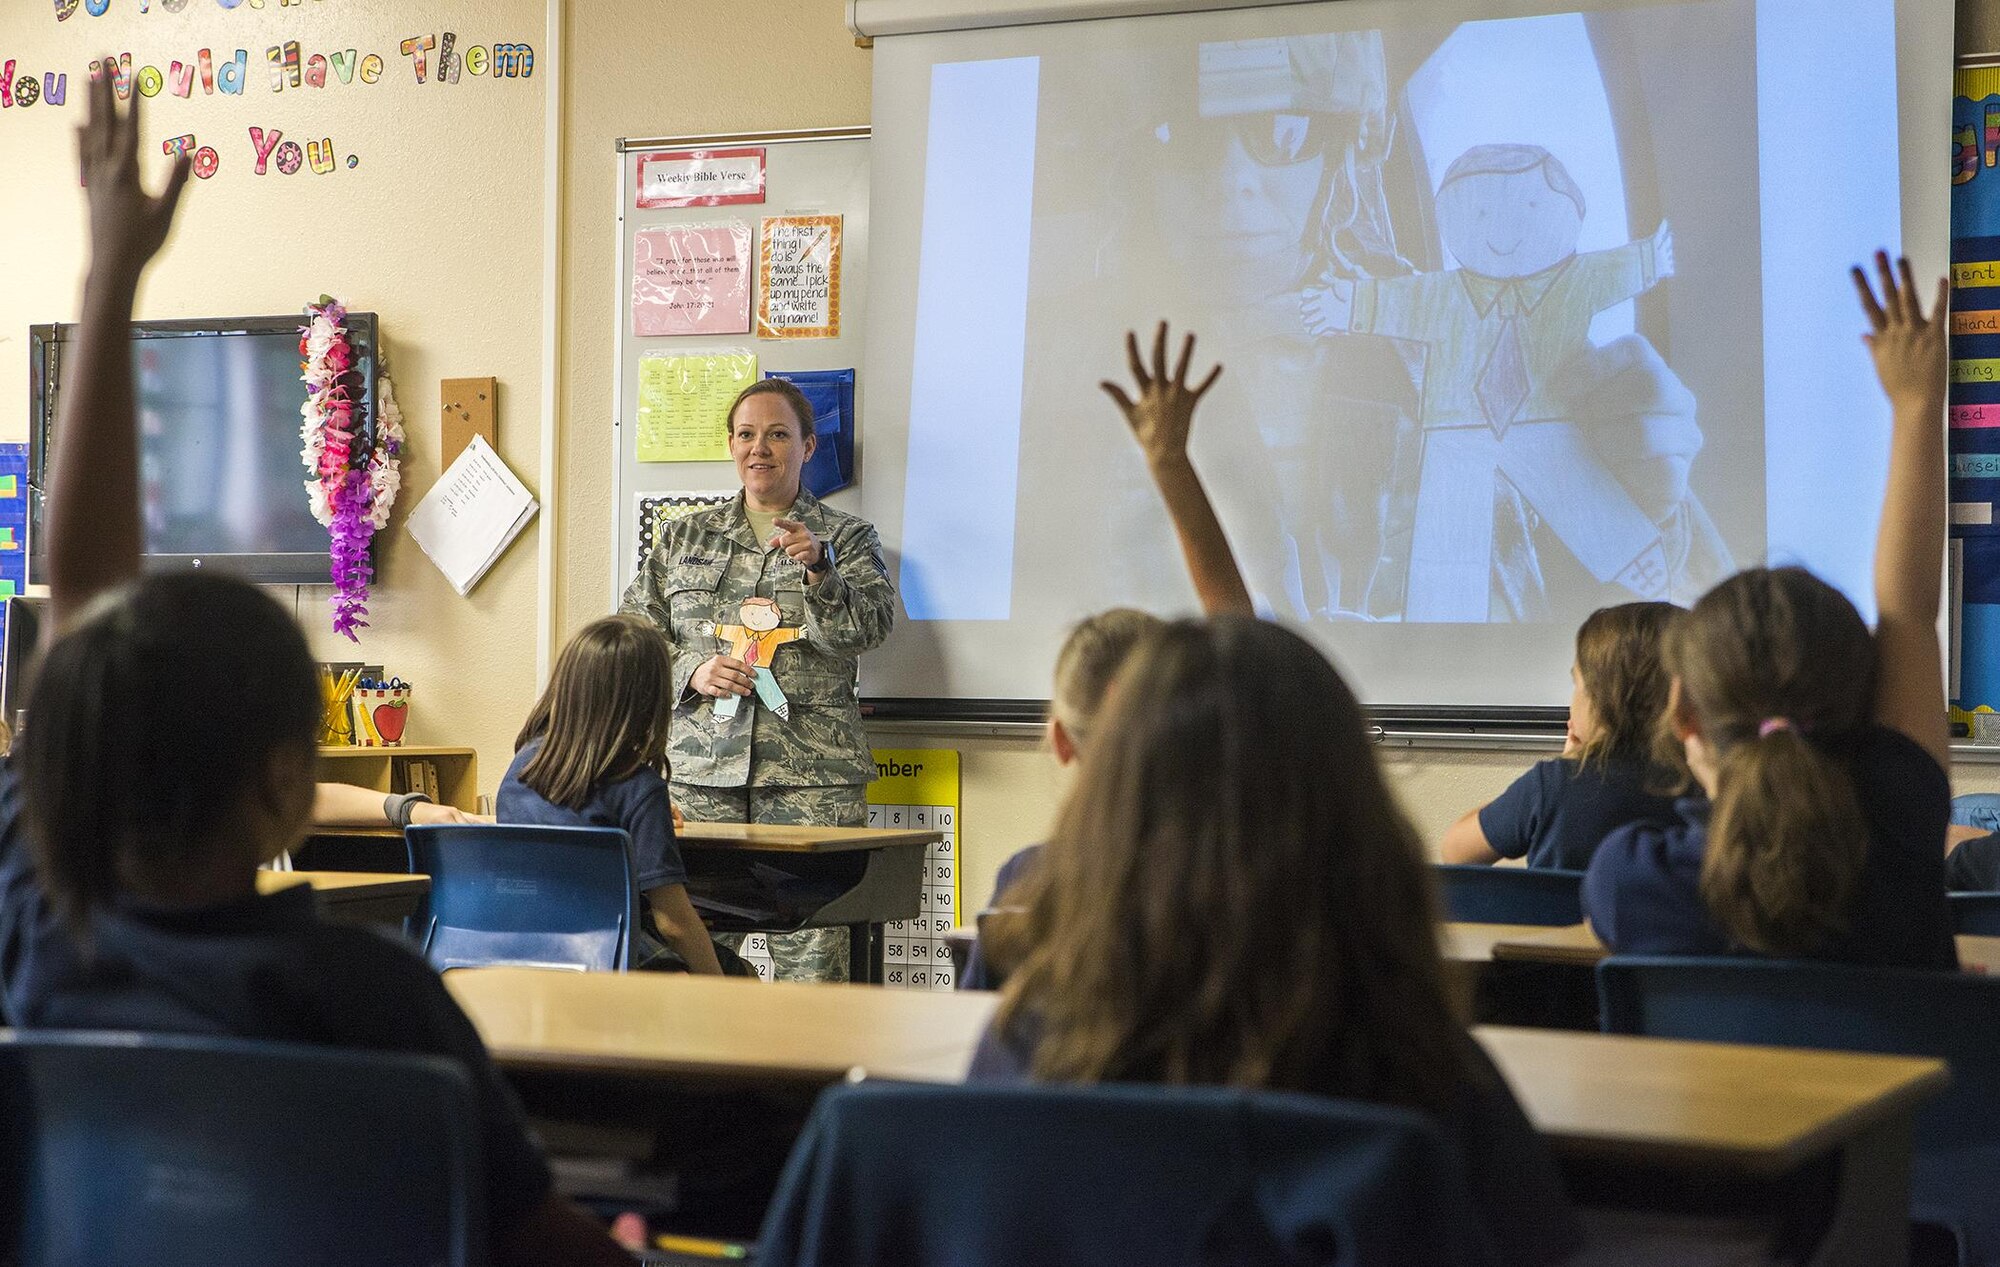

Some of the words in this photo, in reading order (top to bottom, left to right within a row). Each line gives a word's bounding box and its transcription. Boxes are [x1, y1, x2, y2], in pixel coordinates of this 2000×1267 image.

[266, 40, 383, 93] Have
[401, 32, 534, 84] Them
[163, 134, 219, 179] To
[249, 127, 358, 176] You.
[694, 171, 717, 182] Bible
[720, 170, 746, 181] Verse
[1951, 406, 1985, 422] ted
[875, 758, 923, 777] mber
[869, 811, 878, 823] 7
[893, 812, 901, 824] 8
[917, 813, 925, 825] 9
[939, 813, 952, 825] 10
[937, 840, 952, 852] 20
[937, 866, 951, 879] 30
[936, 893, 951, 905] 40
[912, 919, 927, 931] 49
[935, 920, 951, 932] 50
[752, 938, 766, 950] 52
[888, 944, 903, 957] 58
[912, 945, 927, 957] 59
[936, 946, 951, 959] 60
[888, 970, 903, 983] 68
[911, 972, 926, 984] 69
[934, 973, 951, 985] 70
